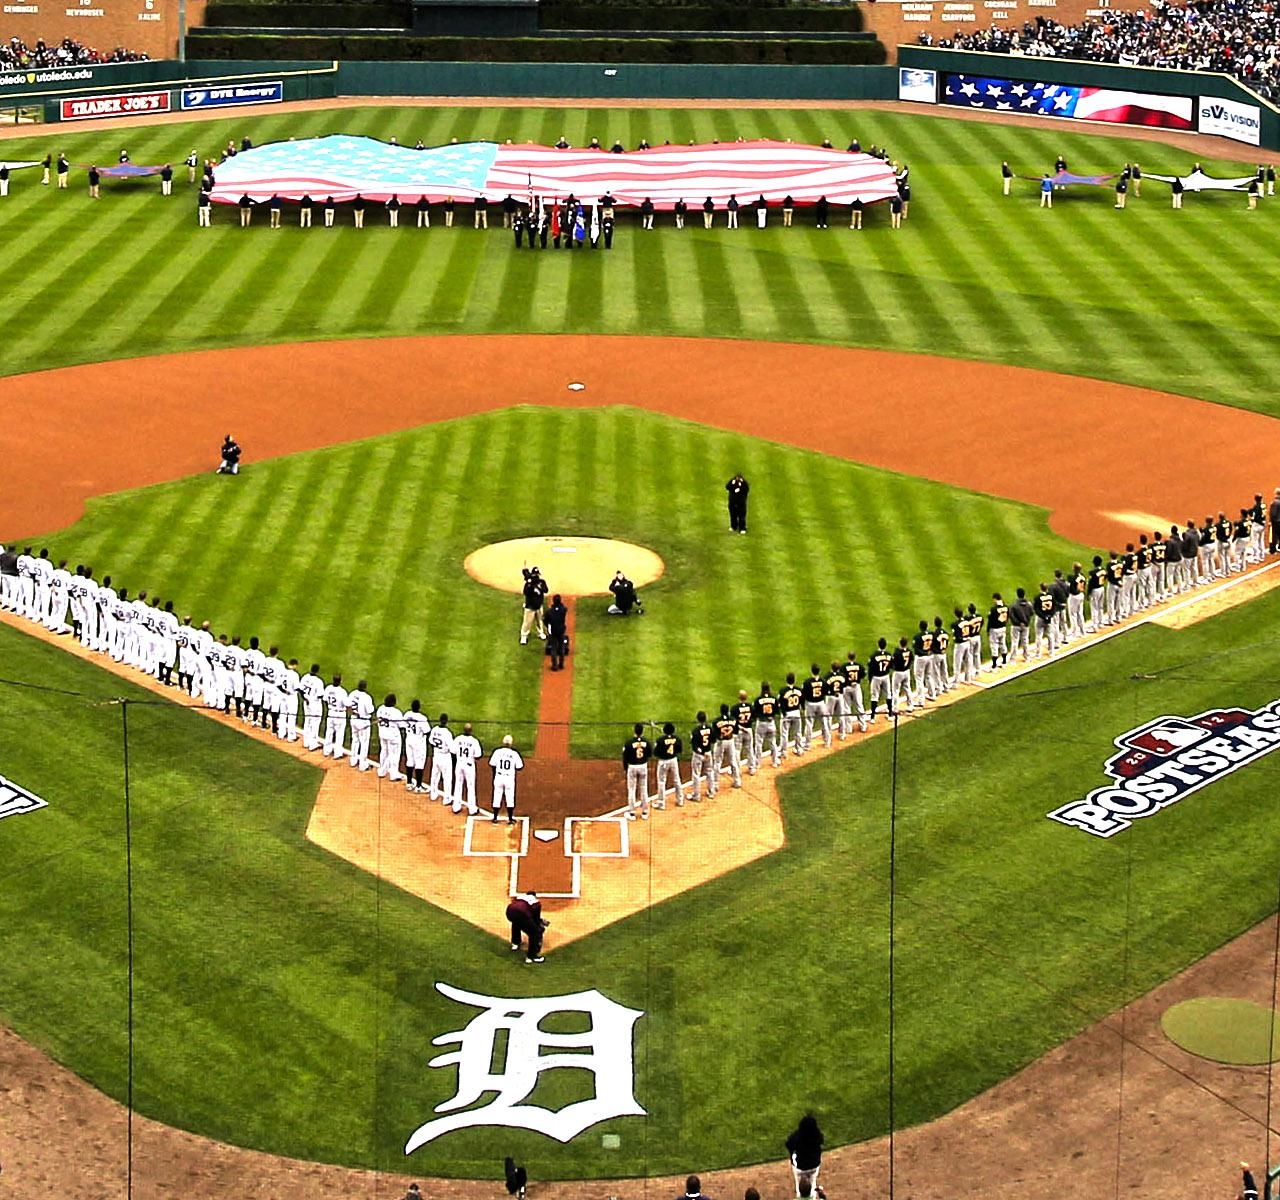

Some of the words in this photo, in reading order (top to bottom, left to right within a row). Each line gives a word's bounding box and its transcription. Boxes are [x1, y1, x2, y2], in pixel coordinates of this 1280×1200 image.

[71, 98, 121, 116] TRADER
[123, 95, 161, 111] JOE'S
[1231, 113, 1259, 129] VISION
[878, 660, 890, 672] 17
[1201, 715, 1225, 728] 12
[702, 735, 709, 747] 5
[459, 746, 469, 758] 14
[636, 748, 643, 759] 6
[666, 744, 674, 755] 4
[499, 758, 511, 770] 10
[1125, 752, 1146, 766] 20
[405, 981, 648, 1156] D
